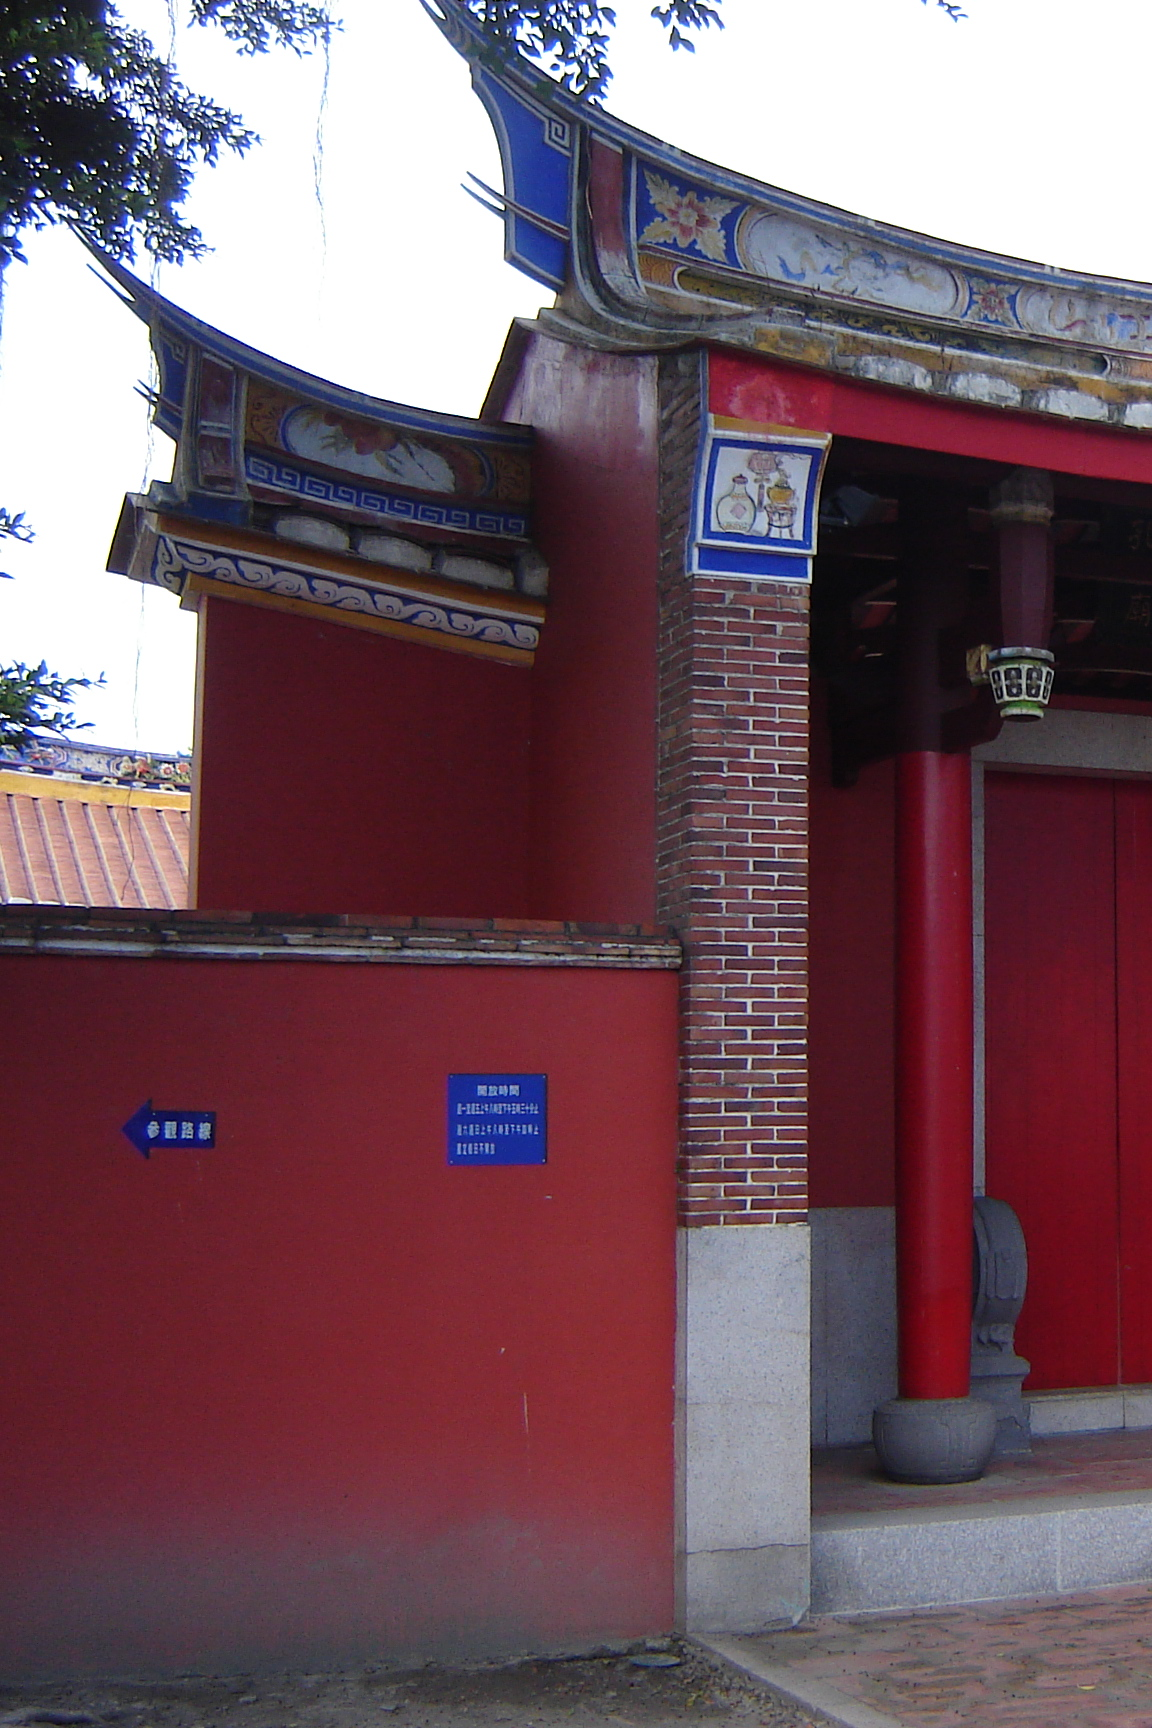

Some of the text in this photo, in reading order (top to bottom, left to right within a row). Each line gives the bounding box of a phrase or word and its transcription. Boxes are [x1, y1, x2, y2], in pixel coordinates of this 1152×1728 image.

[477, 1085, 520, 1096] 開放時間
[147, 1120, 212, 1141] 參觀路線
